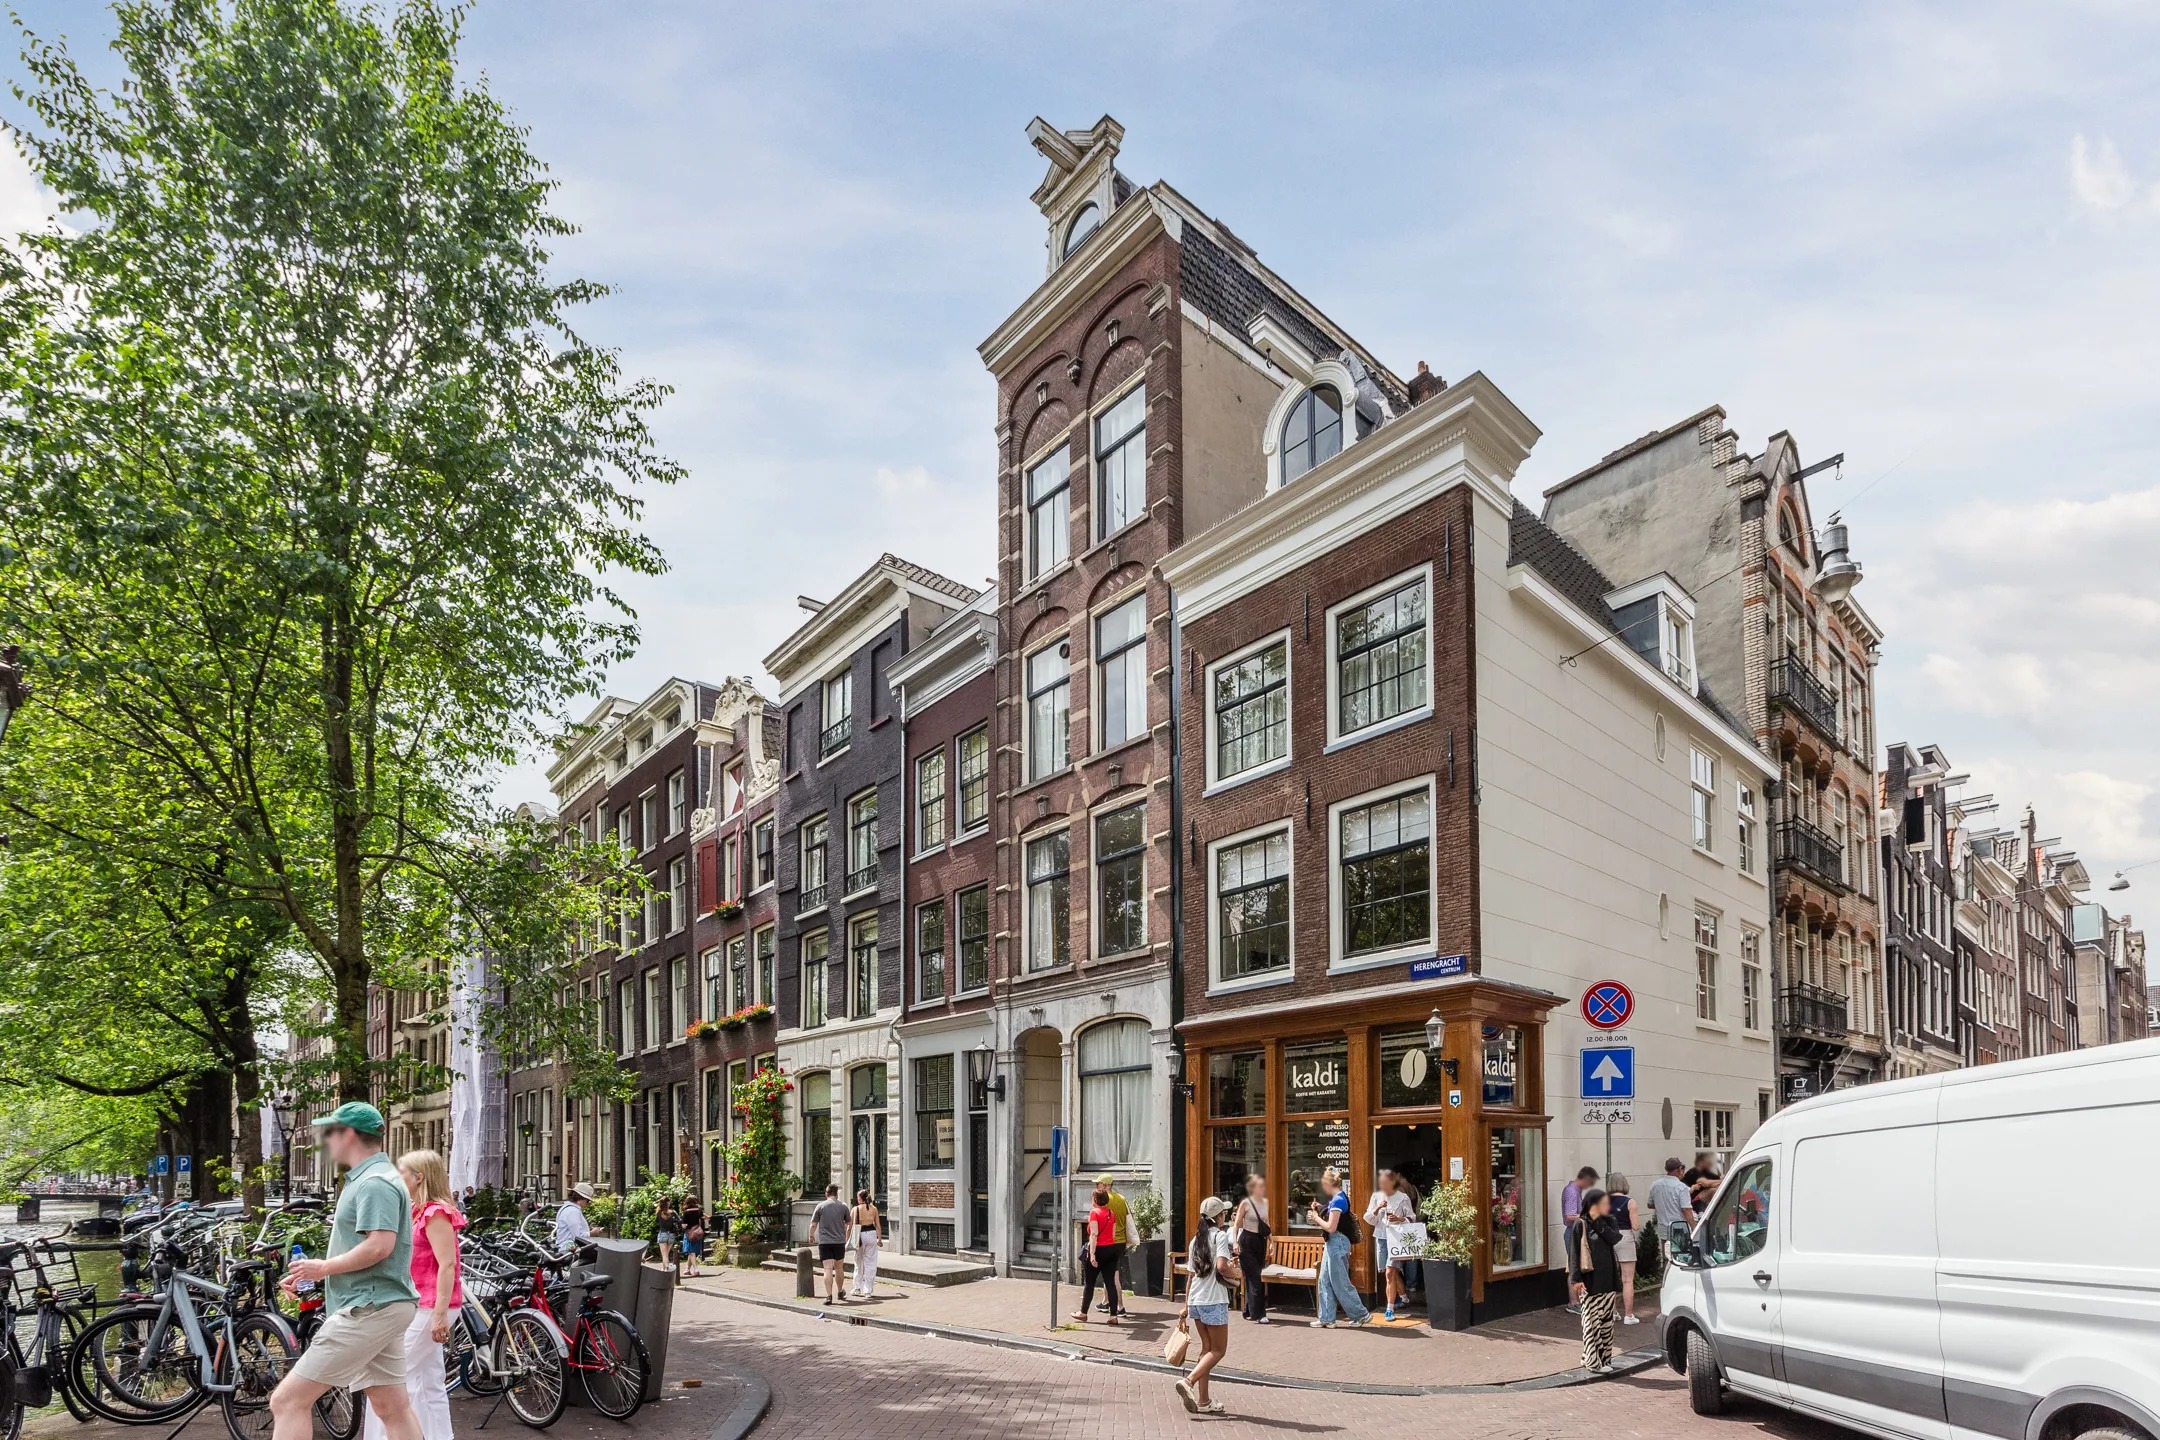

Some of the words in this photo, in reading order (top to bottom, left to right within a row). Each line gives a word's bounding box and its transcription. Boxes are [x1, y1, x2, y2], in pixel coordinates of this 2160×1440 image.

[1413, 957, 1460, 971] HERENGRACHT
[1440, 966, 1461, 974] CENTRUM
[1484, 1049, 1514, 1076] kaldi
[1292, 1061, 1339, 1088] kaldi
[1583, 1100, 1631, 1108] uitgezonderd
[159, 1156, 166, 1166] P
[180, 1157, 188, 1170] P
